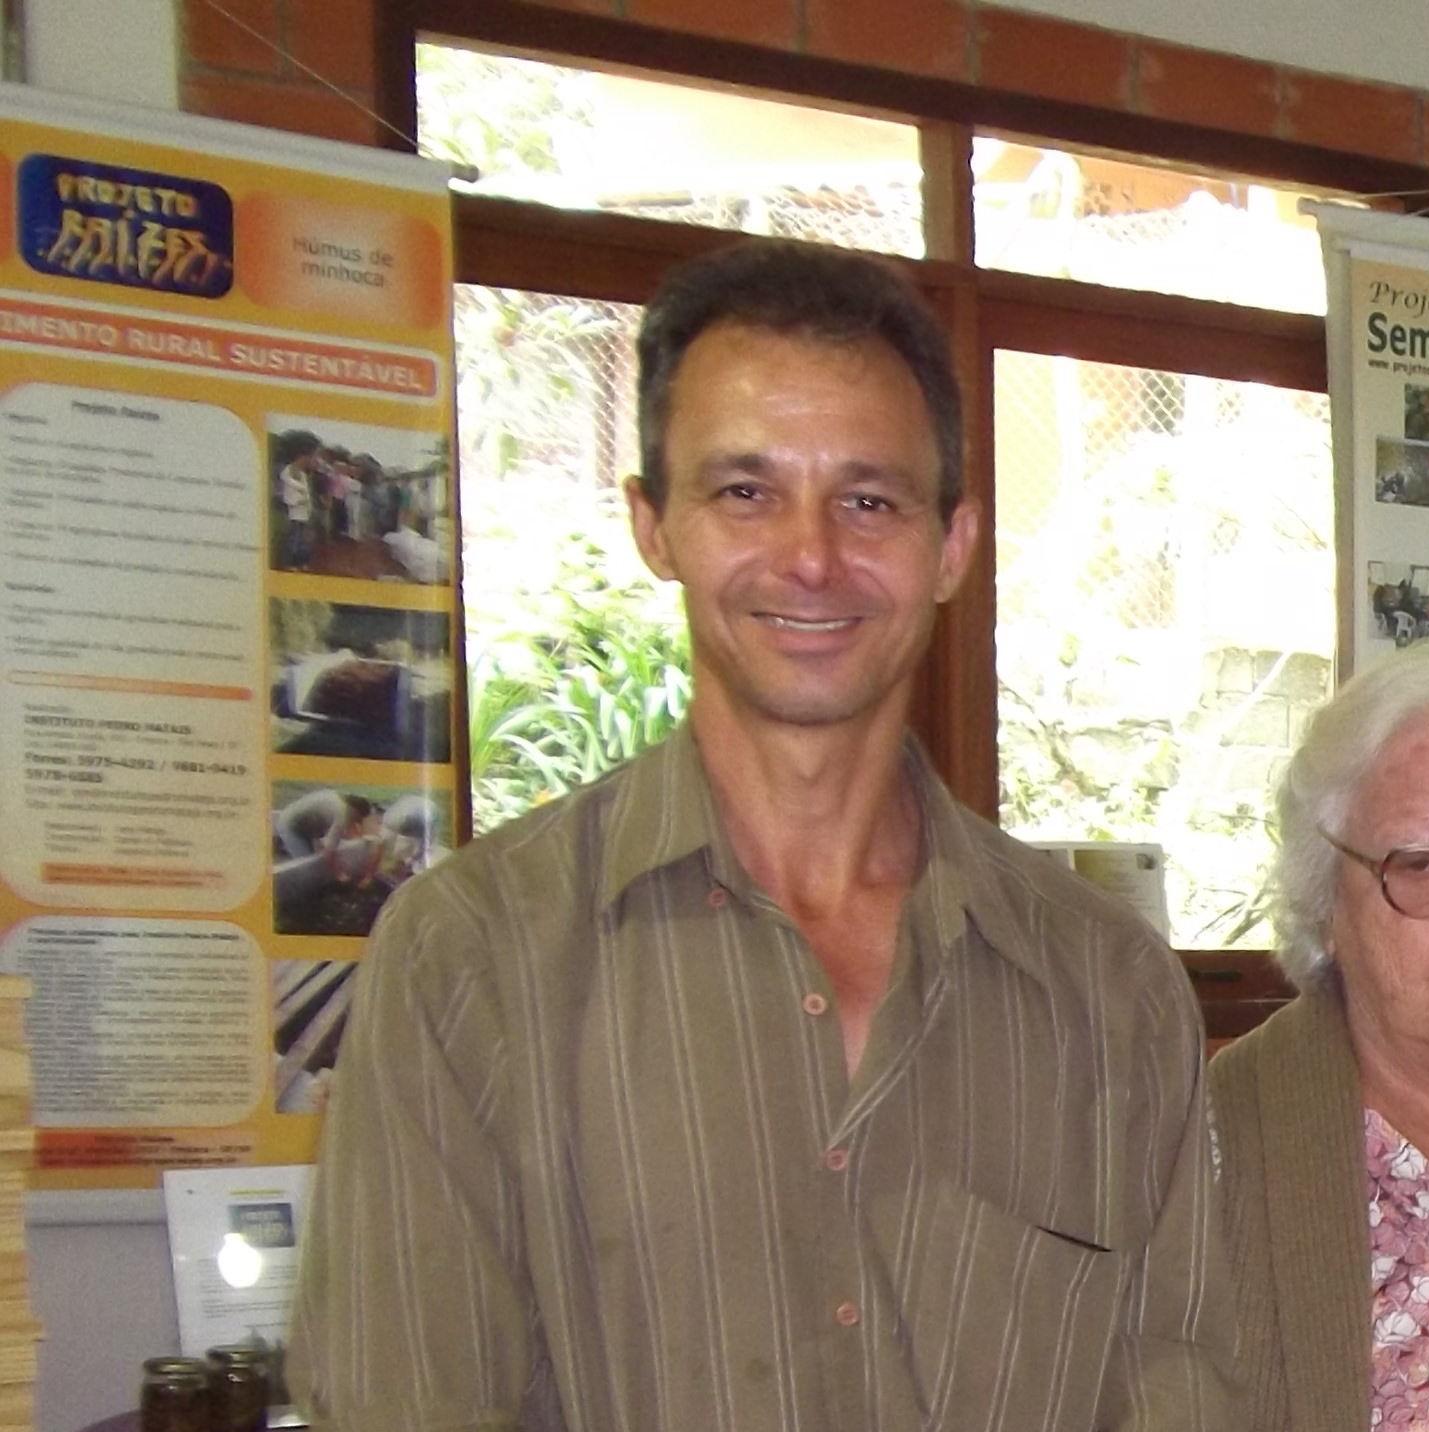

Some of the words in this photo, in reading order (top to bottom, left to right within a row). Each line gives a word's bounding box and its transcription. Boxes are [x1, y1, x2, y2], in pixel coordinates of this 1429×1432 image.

[57, 172, 199, 218] PROJETO
[292, 236, 362, 262] Húmus
[368, 248, 394, 267] de
[301, 261, 385, 288] minhoca
[126, 327, 222, 362] RURAL
[229, 343, 423, 390] SUSTENTÁVEL
